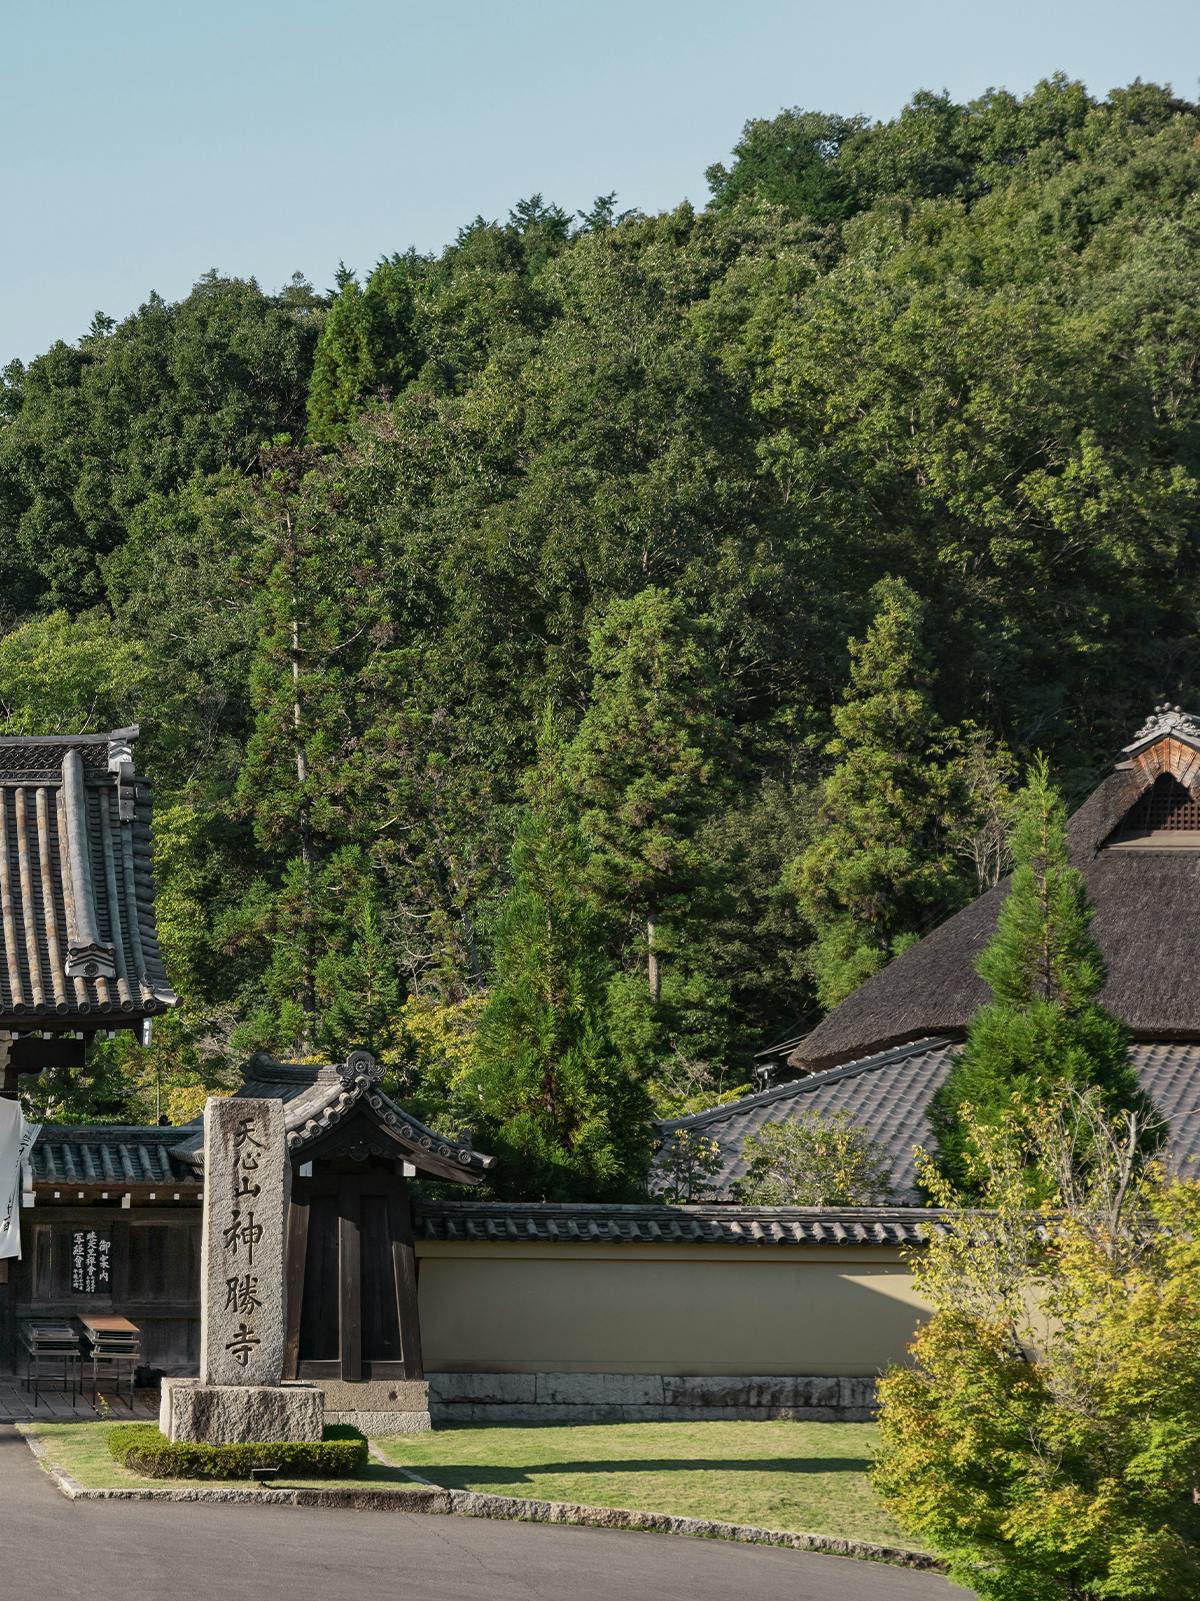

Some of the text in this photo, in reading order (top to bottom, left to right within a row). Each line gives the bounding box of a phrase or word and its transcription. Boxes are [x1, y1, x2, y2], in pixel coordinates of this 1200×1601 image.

[99, 1239, 111, 1282] 御案内
[223, 1117, 264, 1367] 天心山神勝寺
